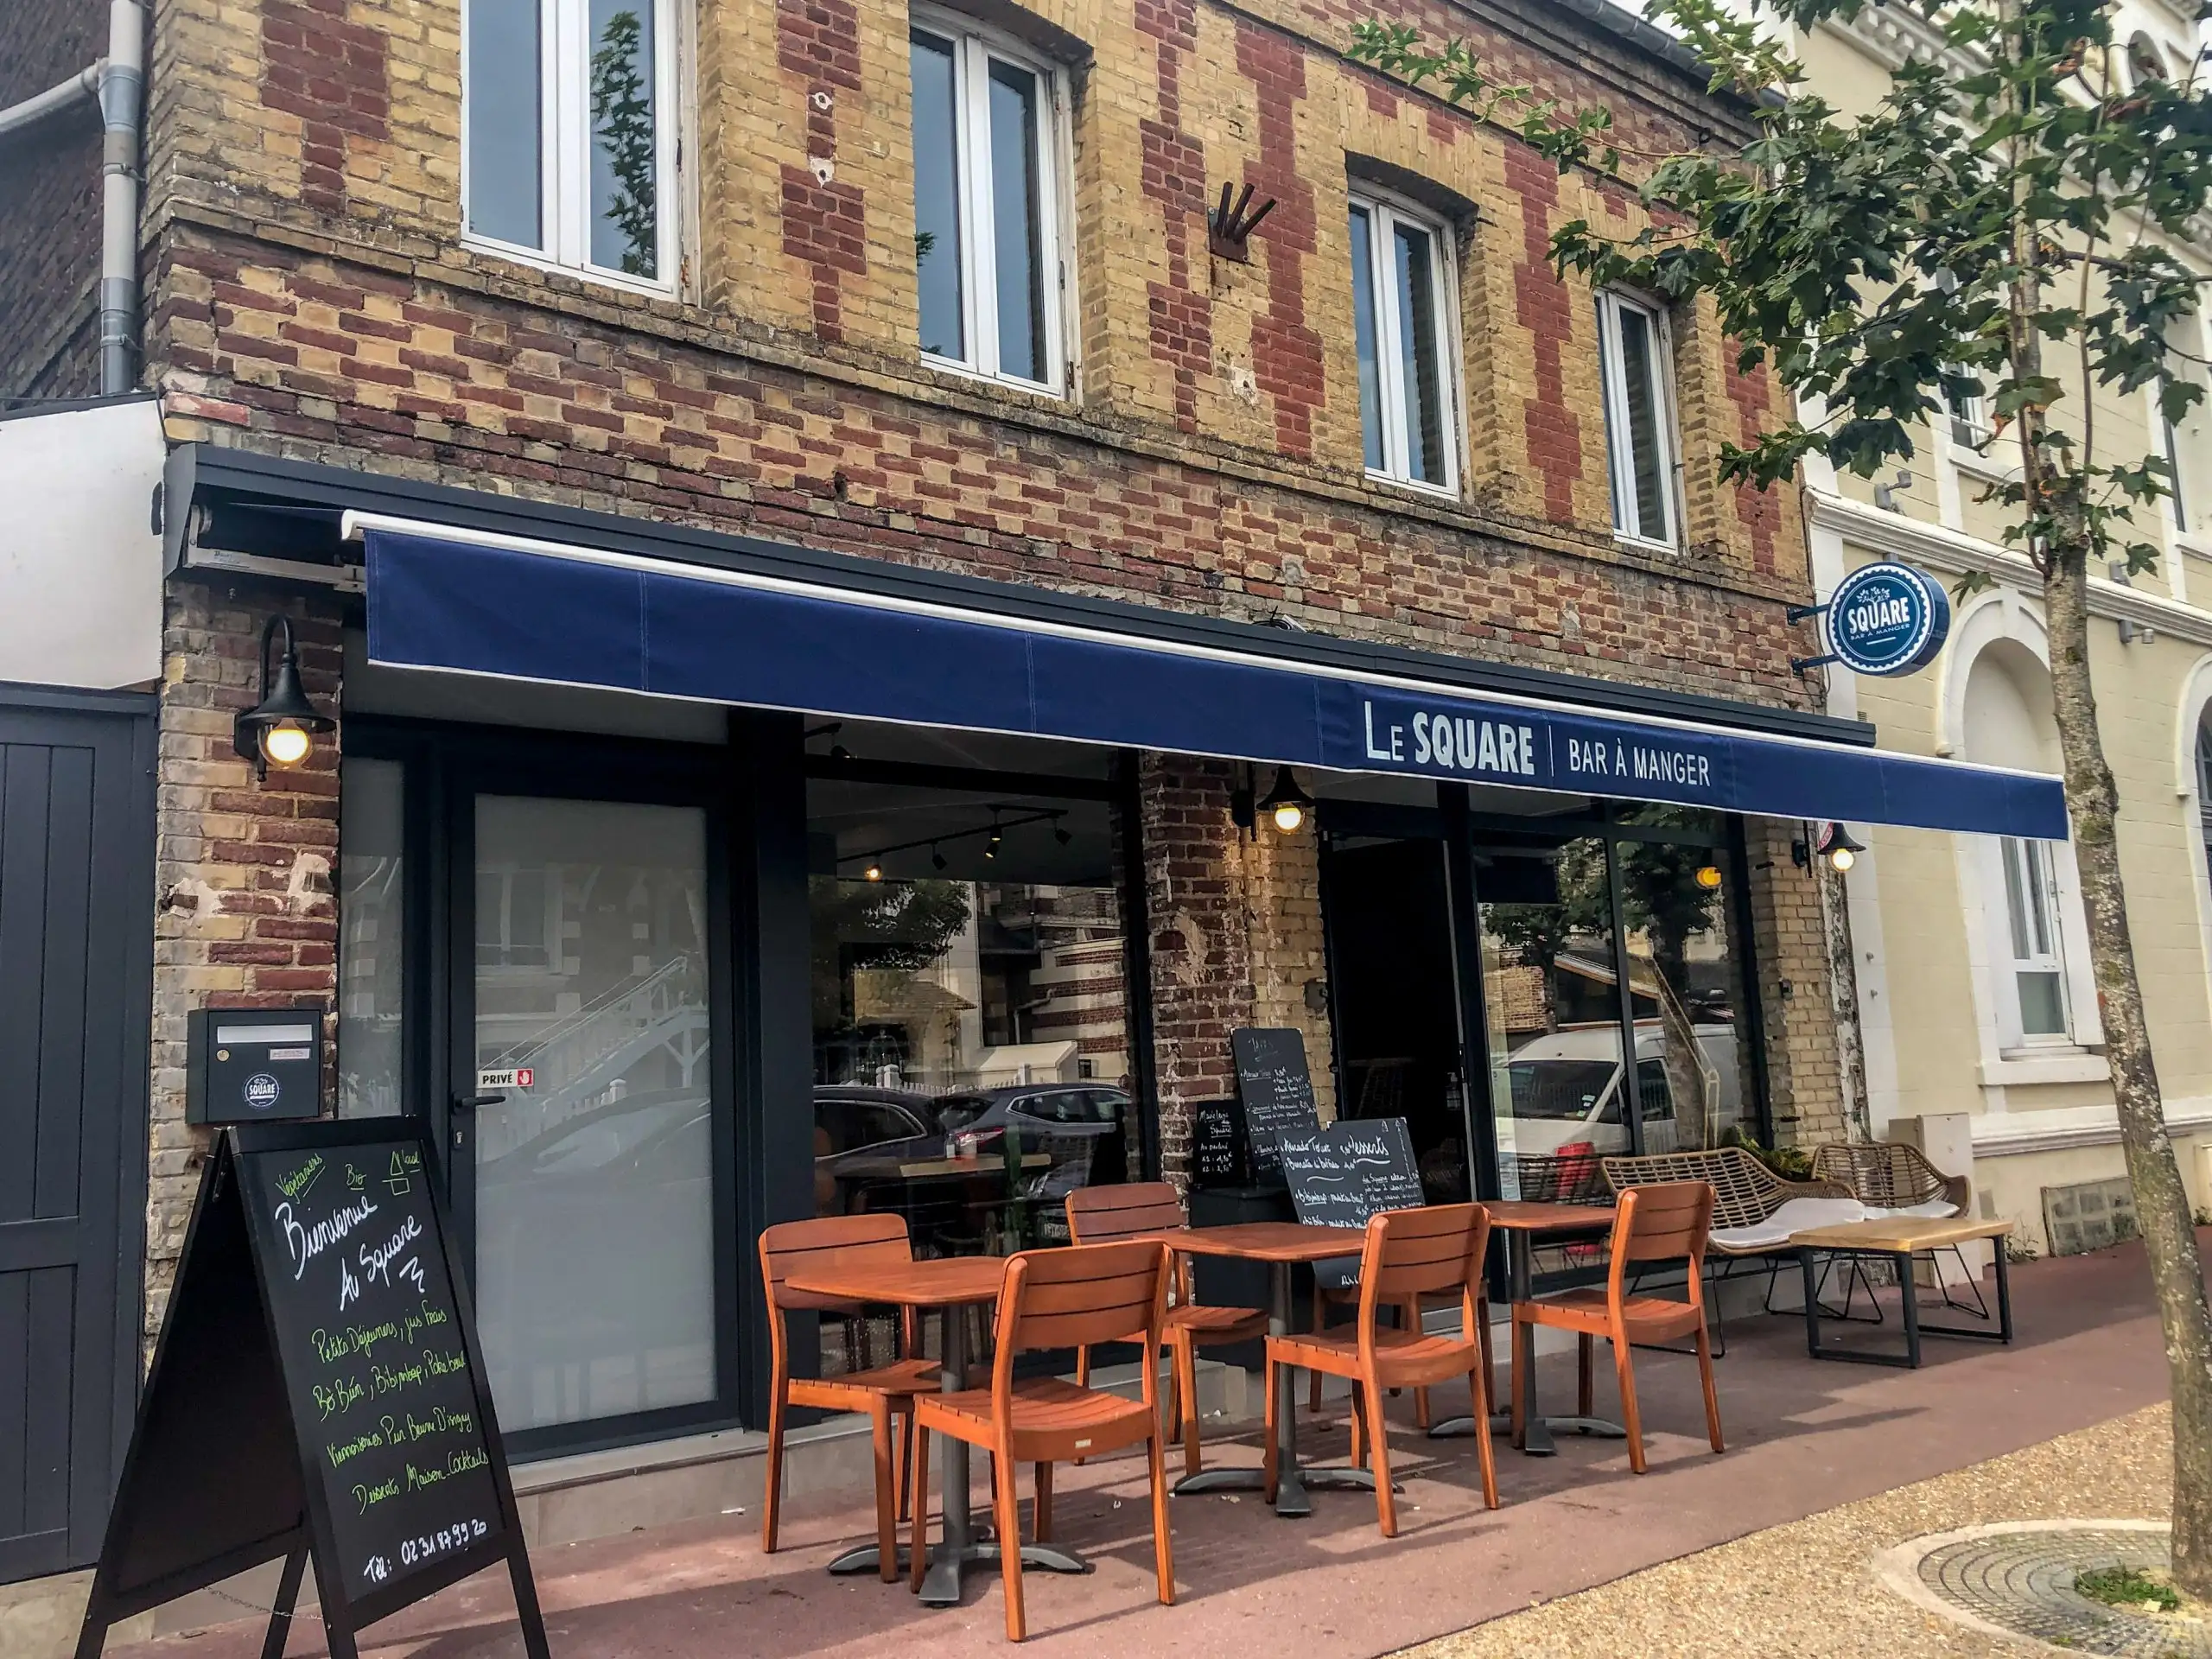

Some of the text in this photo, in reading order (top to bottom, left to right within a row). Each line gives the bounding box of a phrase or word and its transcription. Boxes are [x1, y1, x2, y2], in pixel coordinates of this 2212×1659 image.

[1847, 596, 1910, 634] SQUARE
[1850, 632, 1865, 641] BAR
[1875, 623, 1910, 635] MANGER
[1412, 711, 1535, 776] SQUARE
[1568, 738, 1609, 775] BAR
[1615, 737, 1628, 777] À
[1634, 747, 1711, 787] MANGER
[249, 1084, 276, 1095] SQUARE
[482, 1071, 512, 1084] PRIVÉ
[345, 1163, 367, 1185] Bio
[275, 1195, 378, 1281] Bienvenue
[340, 1215, 423, 1311] Au Square
[311, 1328, 349, 1363] Petits
[404, 1308, 423, 1344] jus
[379, 1414, 407, 1446] Pur
[400, 1539, 419, 1566] 02
[418, 1535, 436, 1558] 31
[436, 1530, 452, 1550] 87
[451, 1522, 469, 1548] 99
[471, 1518, 487, 1536] 20
